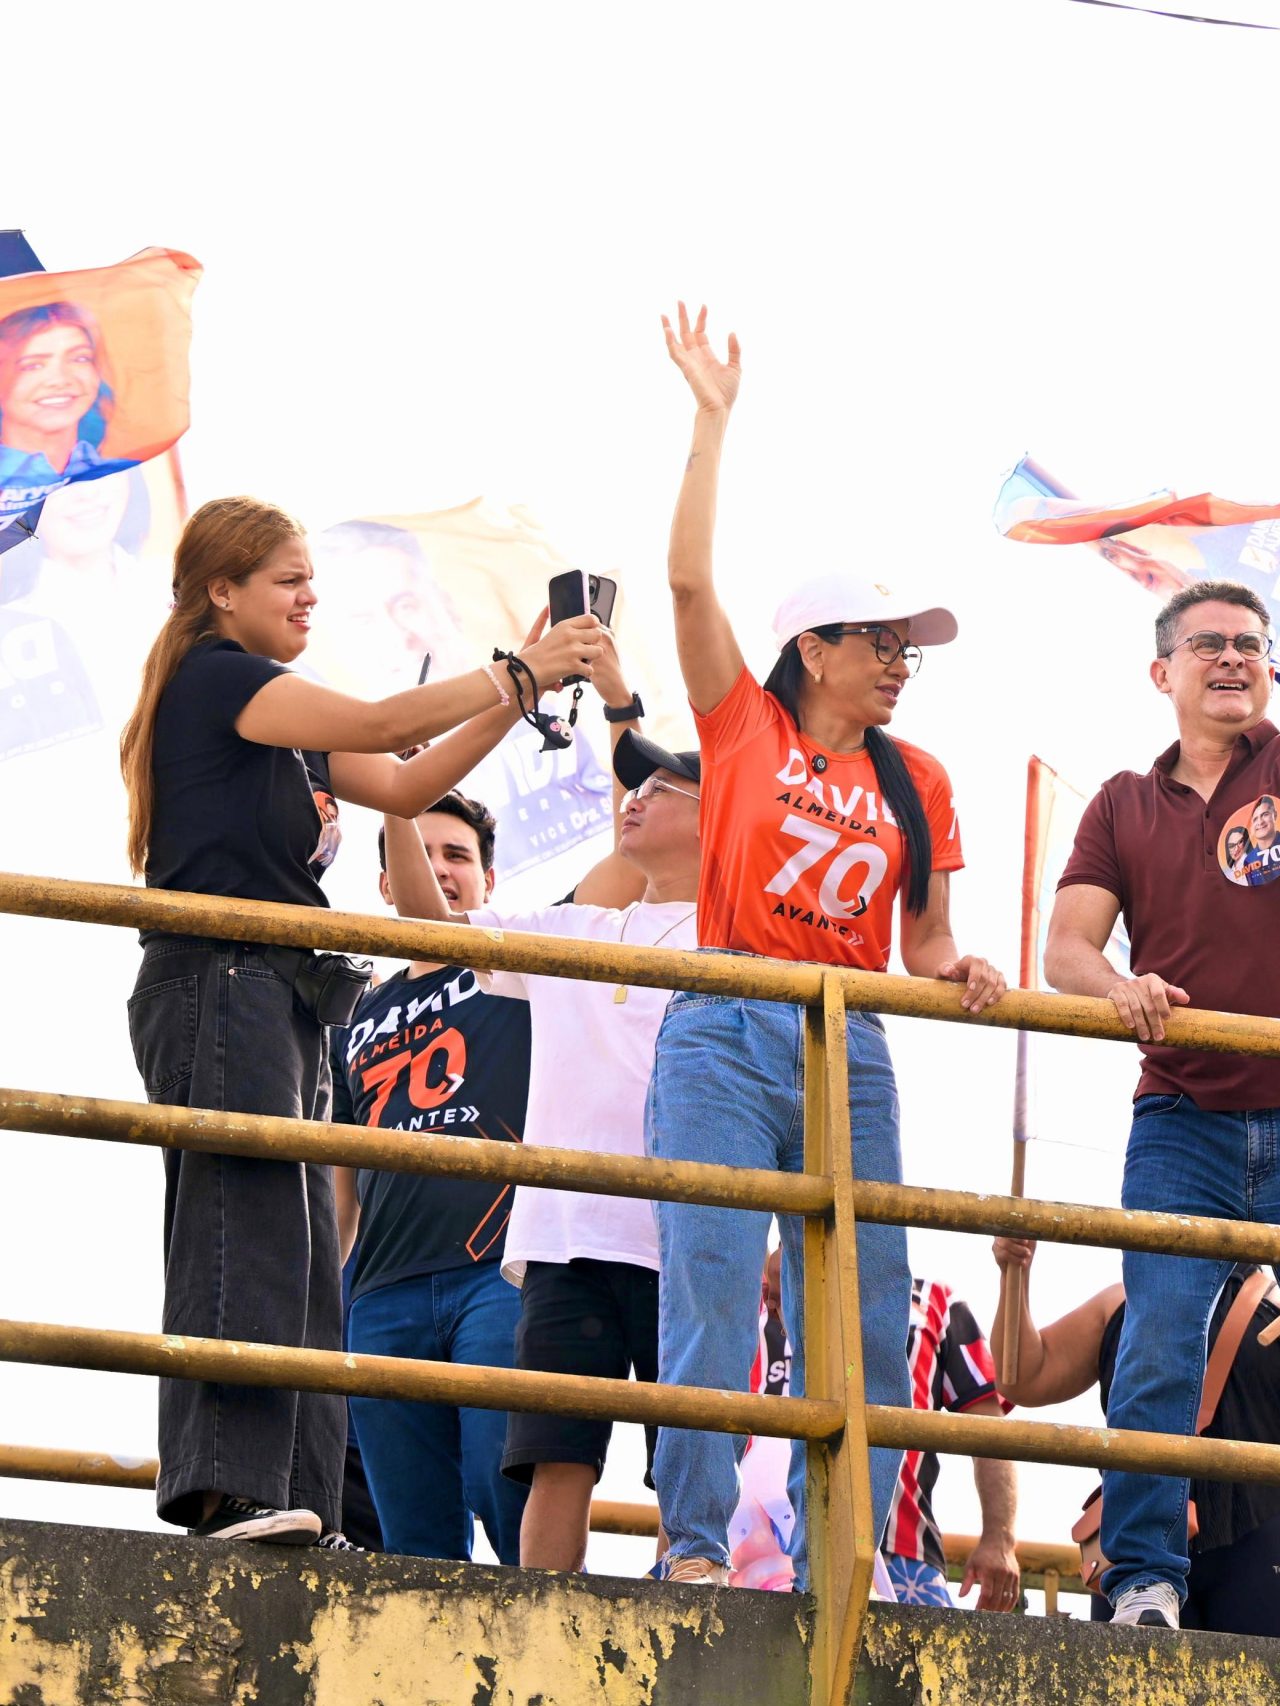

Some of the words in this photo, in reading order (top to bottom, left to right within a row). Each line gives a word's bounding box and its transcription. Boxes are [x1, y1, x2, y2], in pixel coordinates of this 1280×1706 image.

[776, 791, 877, 838] ALMEIDA
[763, 813, 888, 919] 70
[1233, 860, 1262, 879] DAVID
[346, 968, 481, 1064] DAVID
[350, 1017, 443, 1075] ALMEIDA
[361, 1027, 467, 1128] 70
